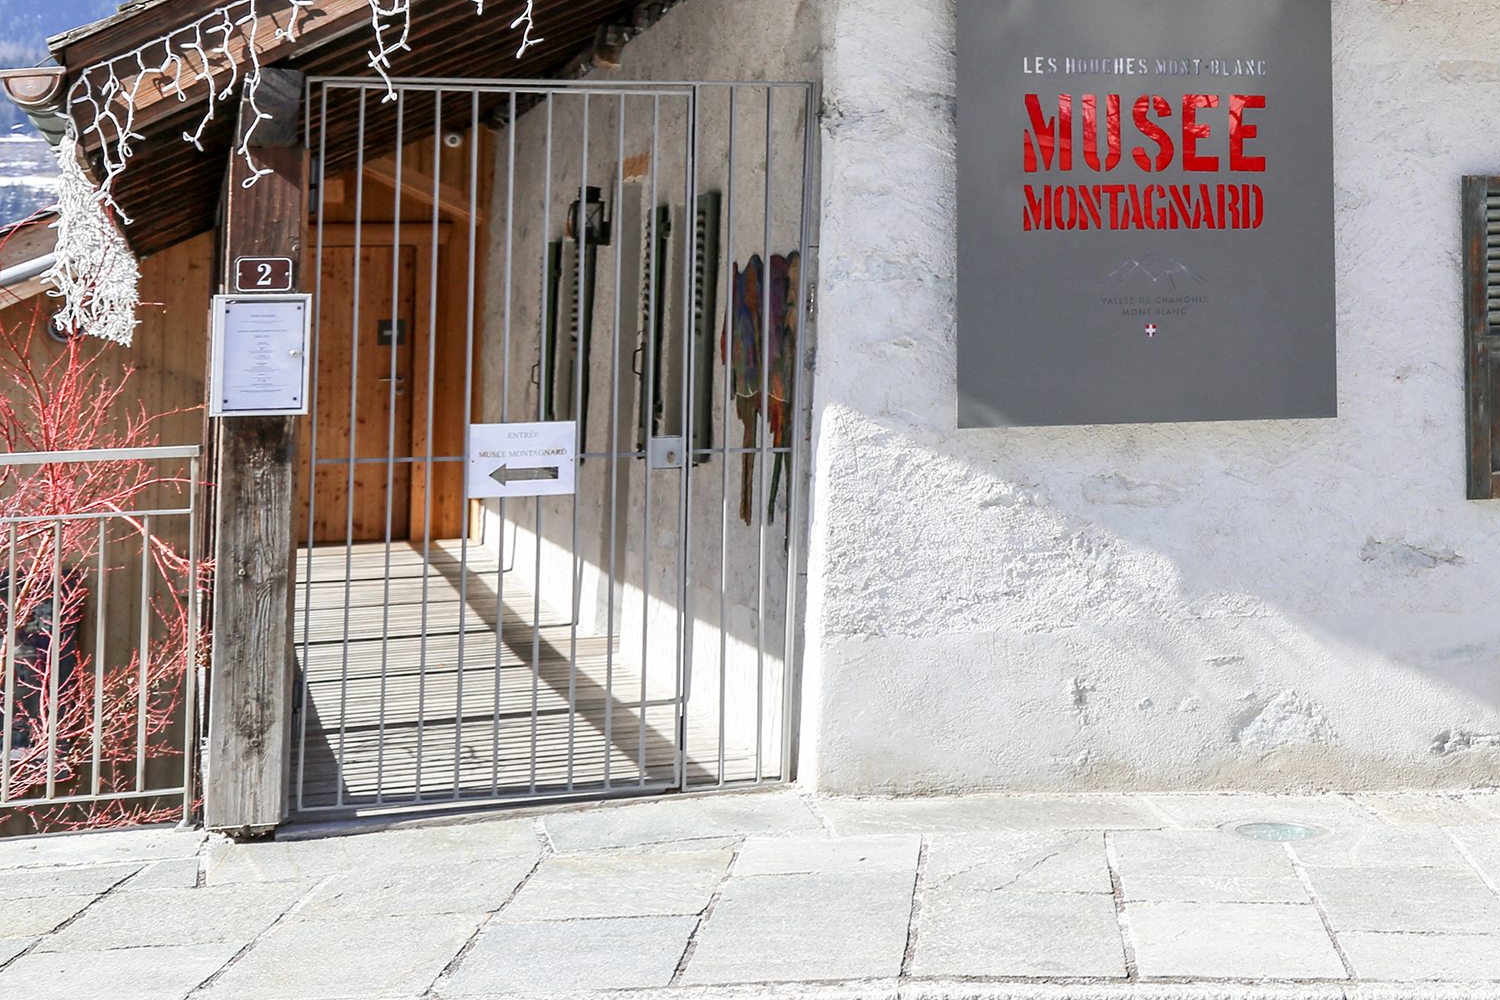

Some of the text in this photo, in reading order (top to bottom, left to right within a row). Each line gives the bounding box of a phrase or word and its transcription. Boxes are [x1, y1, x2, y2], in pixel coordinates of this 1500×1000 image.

[1023, 56, 1058, 74] LES
[1065, 57, 1148, 75] HOUCHES
[1023, 93, 1266, 172] MUSEE
[1023, 183, 1264, 231] MONTAGNARD
[256, 263, 272, 286] 2
[1156, 308, 1187, 316] BLANC
[509, 448, 567, 457] MONTAGNARD
